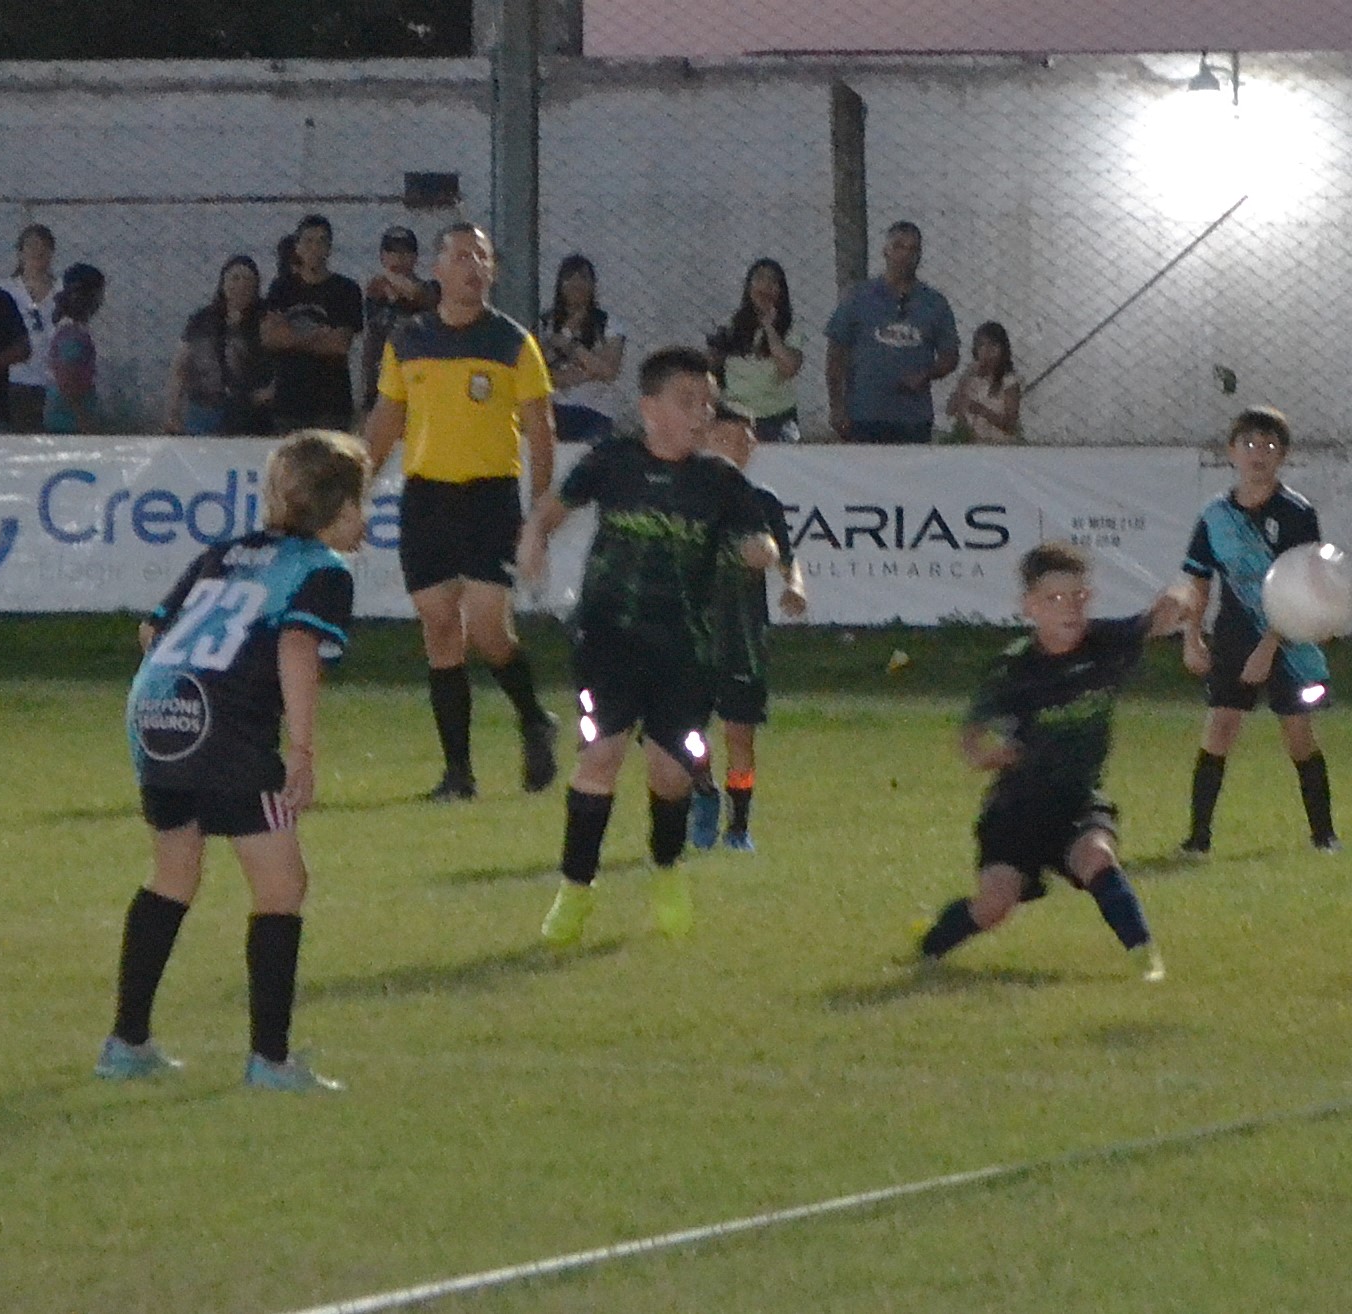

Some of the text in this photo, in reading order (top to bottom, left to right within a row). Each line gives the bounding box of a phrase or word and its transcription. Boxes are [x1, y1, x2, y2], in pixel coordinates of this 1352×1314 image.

[38, 469, 400, 549] Credia
[807, 560, 985, 578] ULTIMARCA
[150, 578, 267, 671] 23
